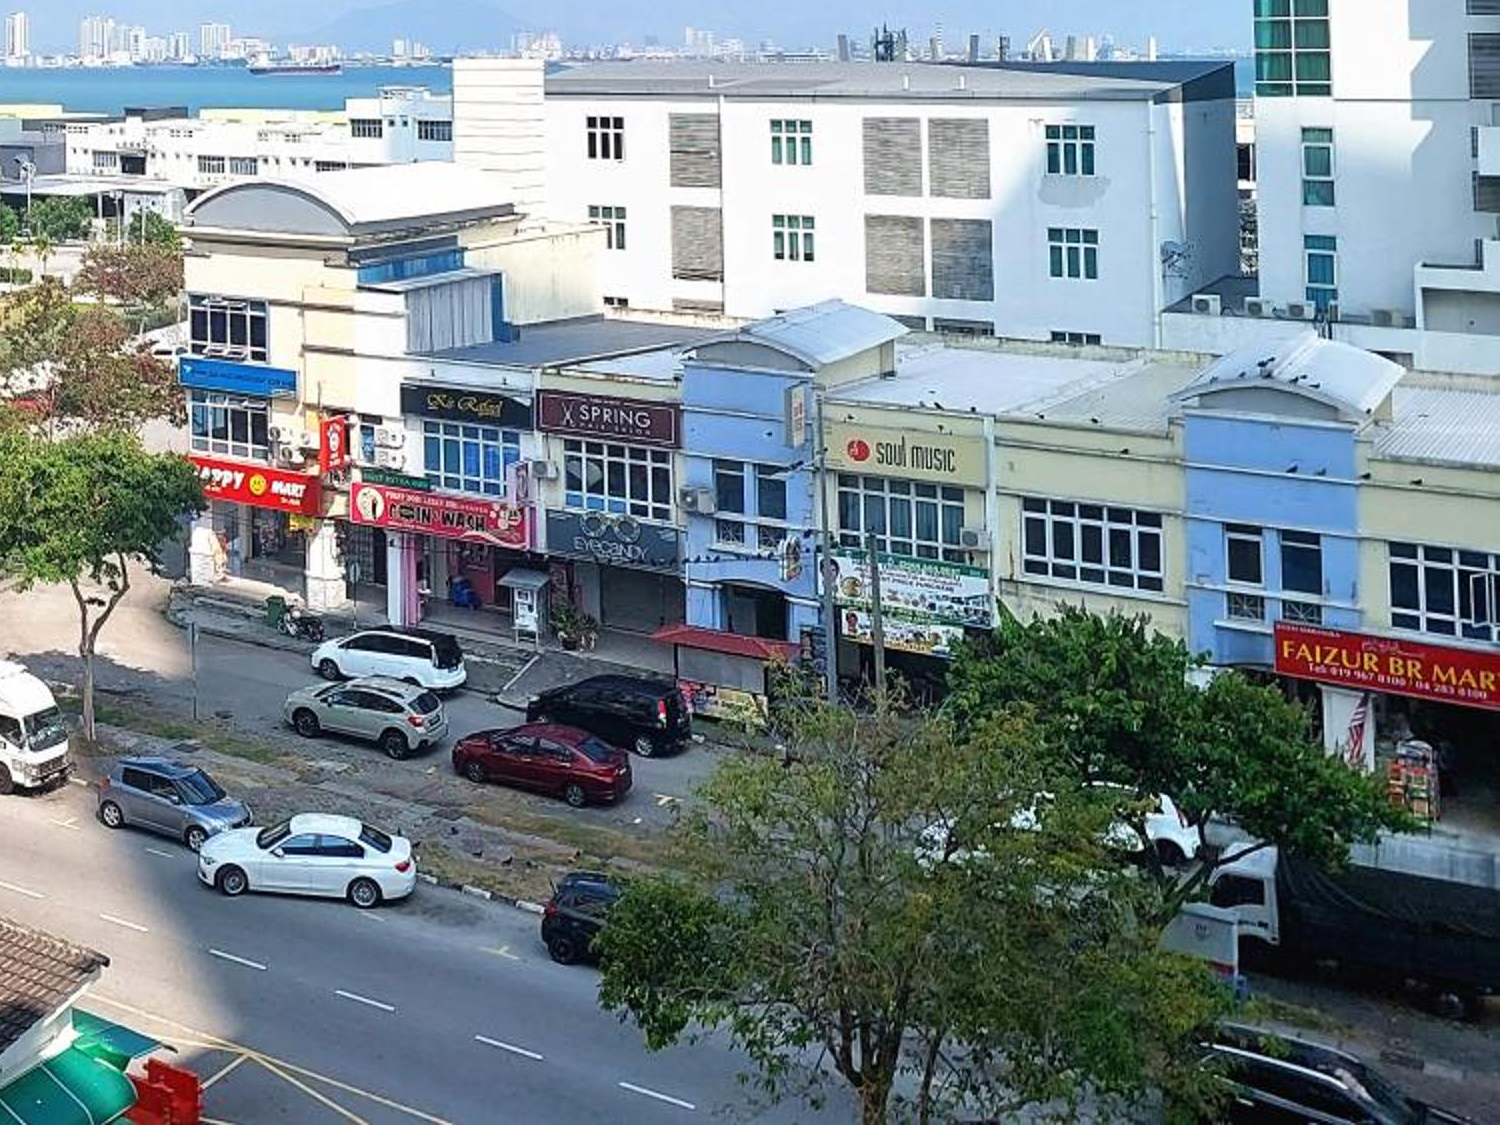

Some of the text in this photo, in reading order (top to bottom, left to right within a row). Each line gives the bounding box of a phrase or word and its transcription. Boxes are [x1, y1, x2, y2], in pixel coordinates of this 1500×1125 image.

[579, 404, 651, 428] SPRING
[271, 480, 306, 497] MART
[441, 509, 487, 532] WASH
[1282, 639, 1379, 673] FAIZUR
[1389, 655, 1423, 680] BR
[1431, 663, 1500, 692] MAR
